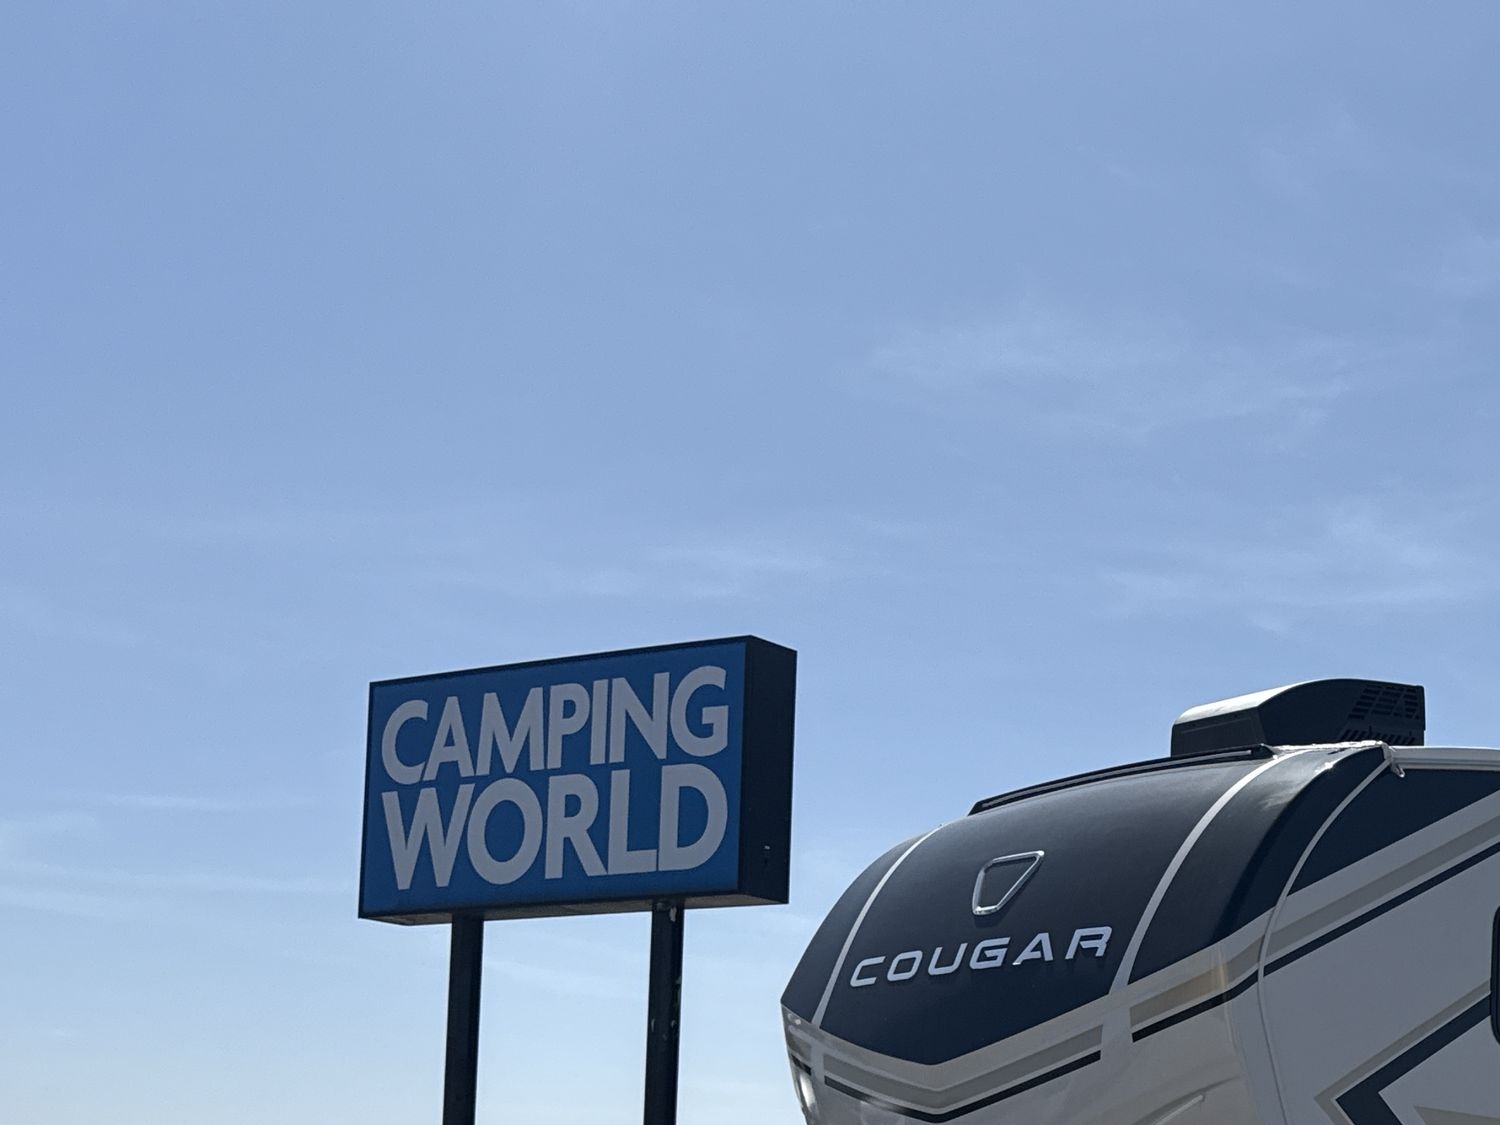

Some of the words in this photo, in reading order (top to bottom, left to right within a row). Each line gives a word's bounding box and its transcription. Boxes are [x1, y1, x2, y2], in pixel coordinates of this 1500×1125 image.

[381, 665, 729, 785] CAMPING
[381, 763, 729, 890] WORLD
[850, 926, 1113, 988] COUGAR
